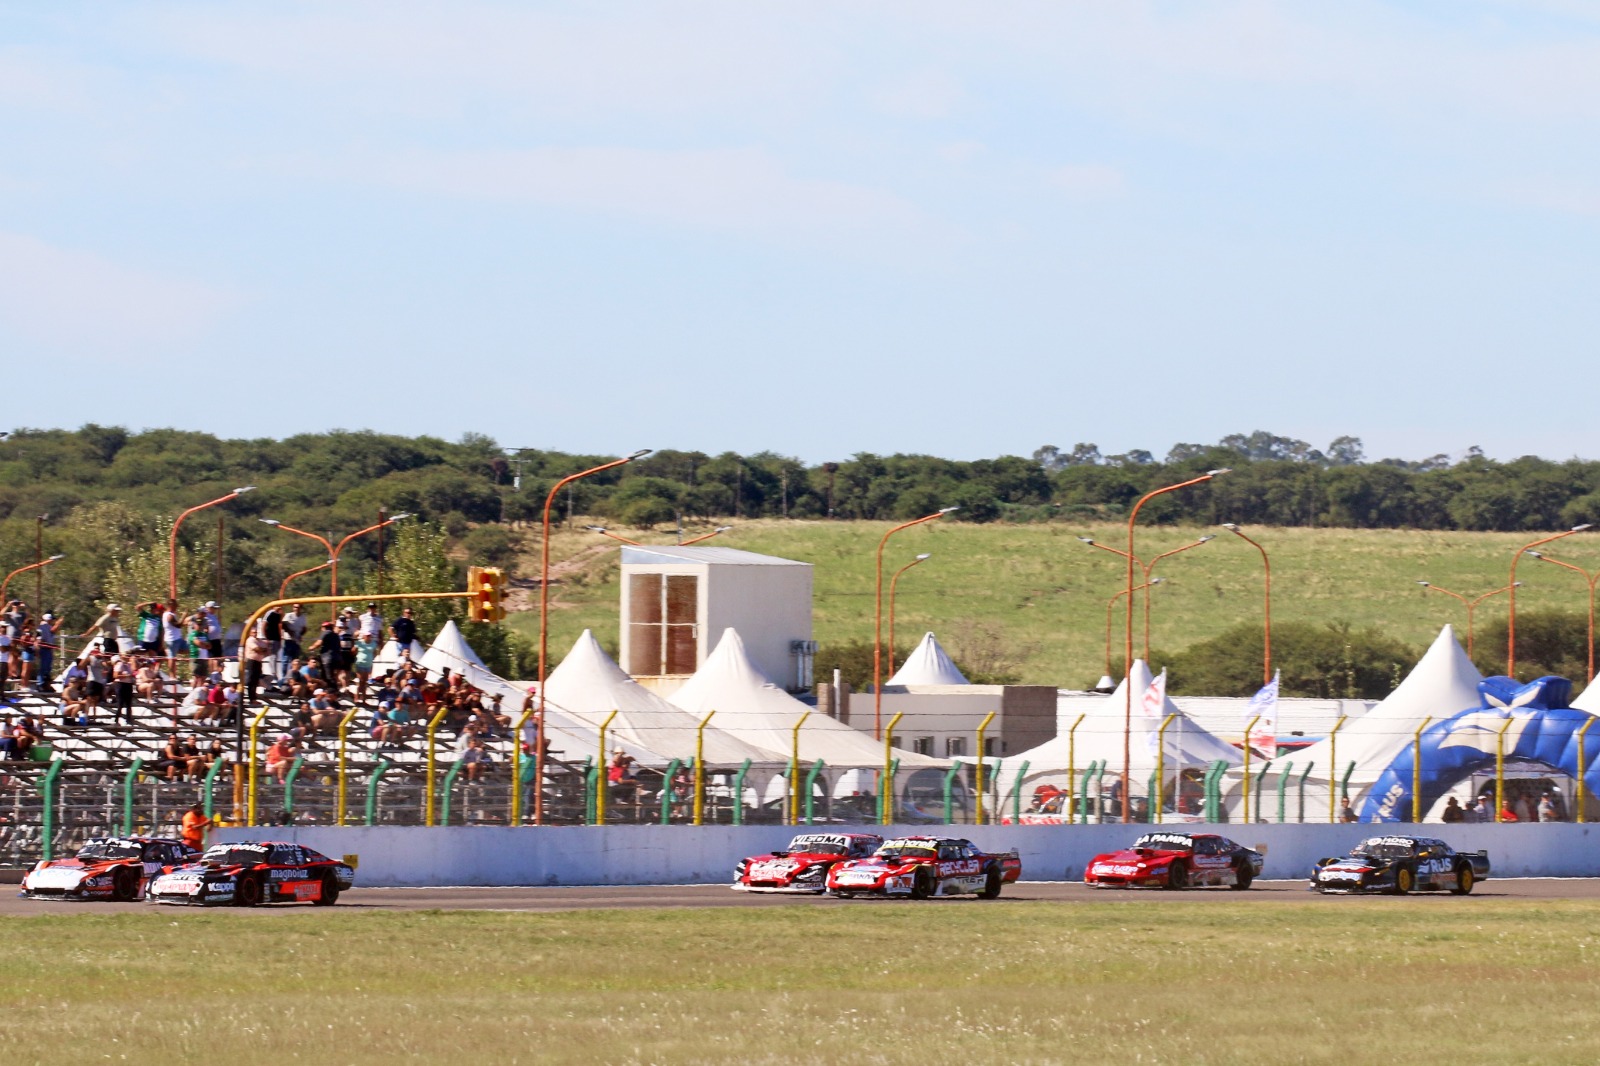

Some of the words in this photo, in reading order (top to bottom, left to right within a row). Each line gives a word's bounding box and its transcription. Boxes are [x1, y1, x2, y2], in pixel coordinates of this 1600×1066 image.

[1378, 784, 1404, 817] RUS
[1136, 834, 1150, 844] LA
[1150, 834, 1193, 847] PAMPA
[940, 860, 979, 876] RECYCLER
[1430, 858, 1453, 872] RUS
[270, 869, 309, 881] magnoluz
